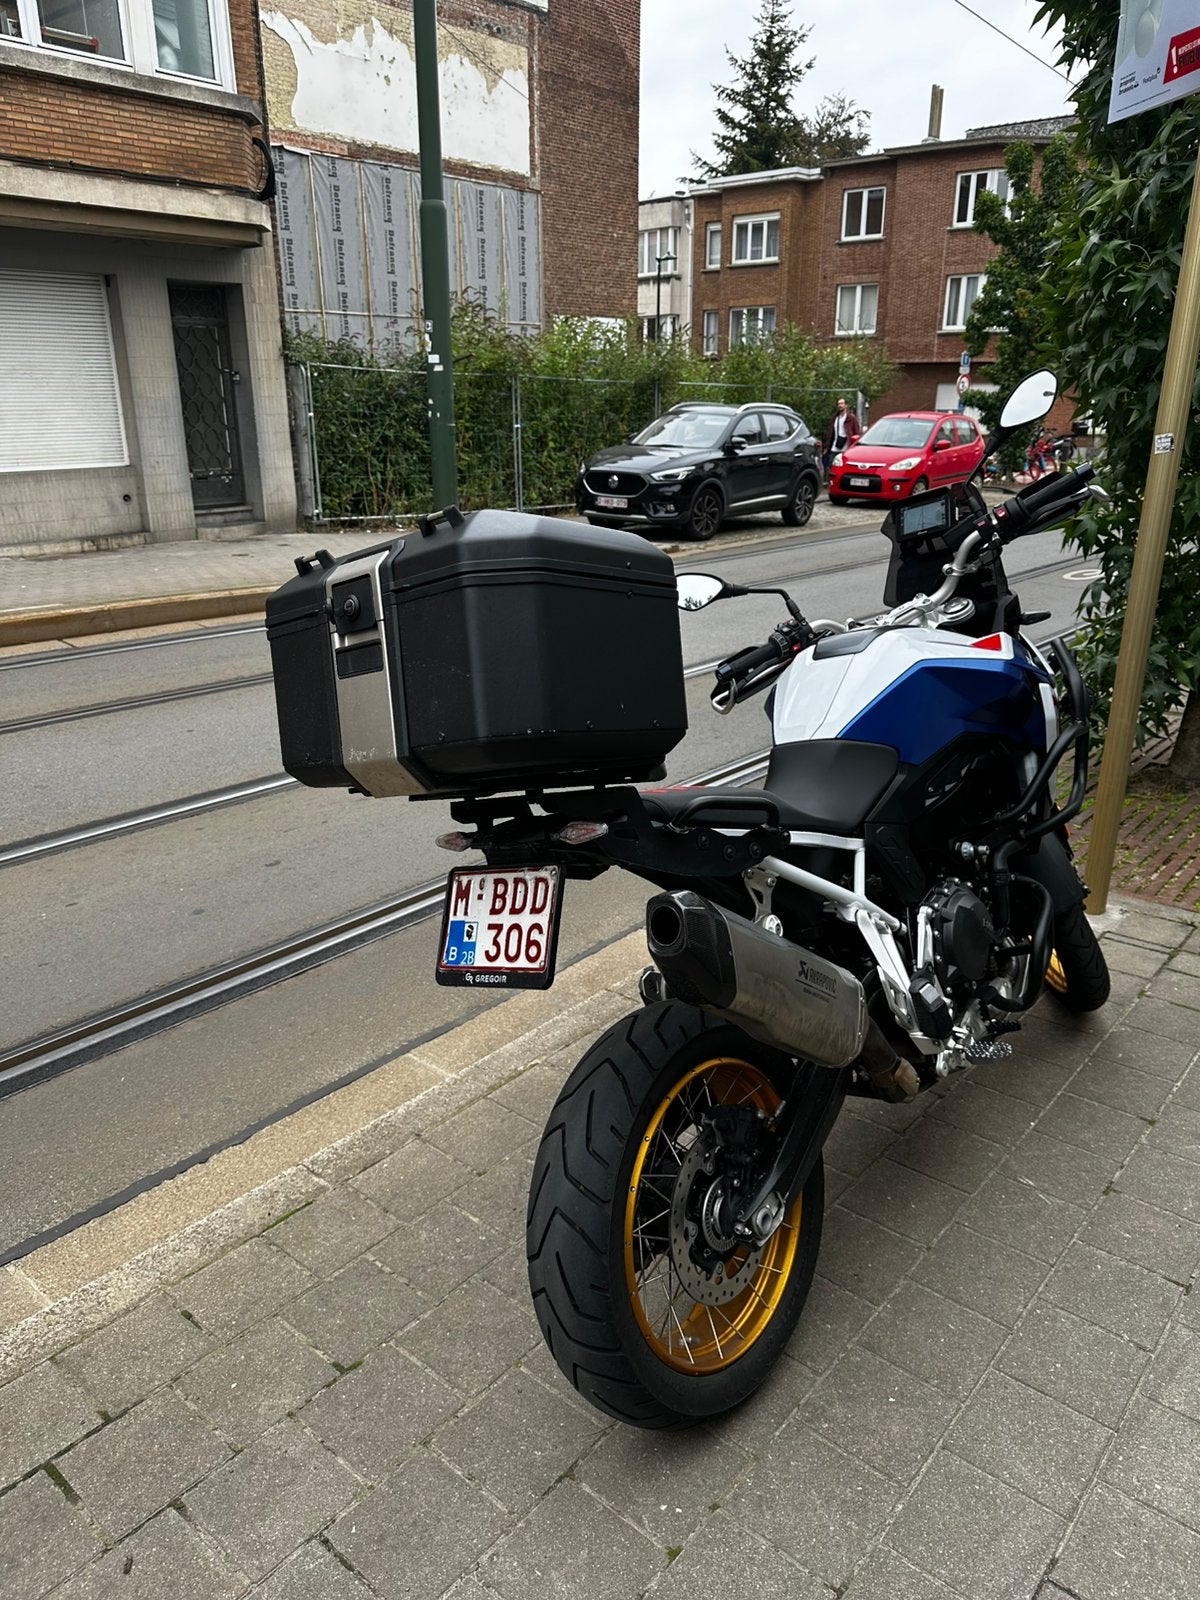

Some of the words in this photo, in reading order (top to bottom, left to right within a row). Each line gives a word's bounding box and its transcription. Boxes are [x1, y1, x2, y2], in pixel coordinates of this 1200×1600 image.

[280, 181, 291, 231] Defrancq
[332, 184, 342, 232] Defrancq
[384, 177, 393, 223] Defrancq
[286, 238, 296, 287] Defrancq
[337, 239, 346, 286] Defrancq
[387, 230, 395, 275] Defrancq
[448, 947, 458, 961] B
[461, 951, 474, 965] 2B
[485, 922, 543, 963] 306
[475, 974, 507, 983] GREGOIR
